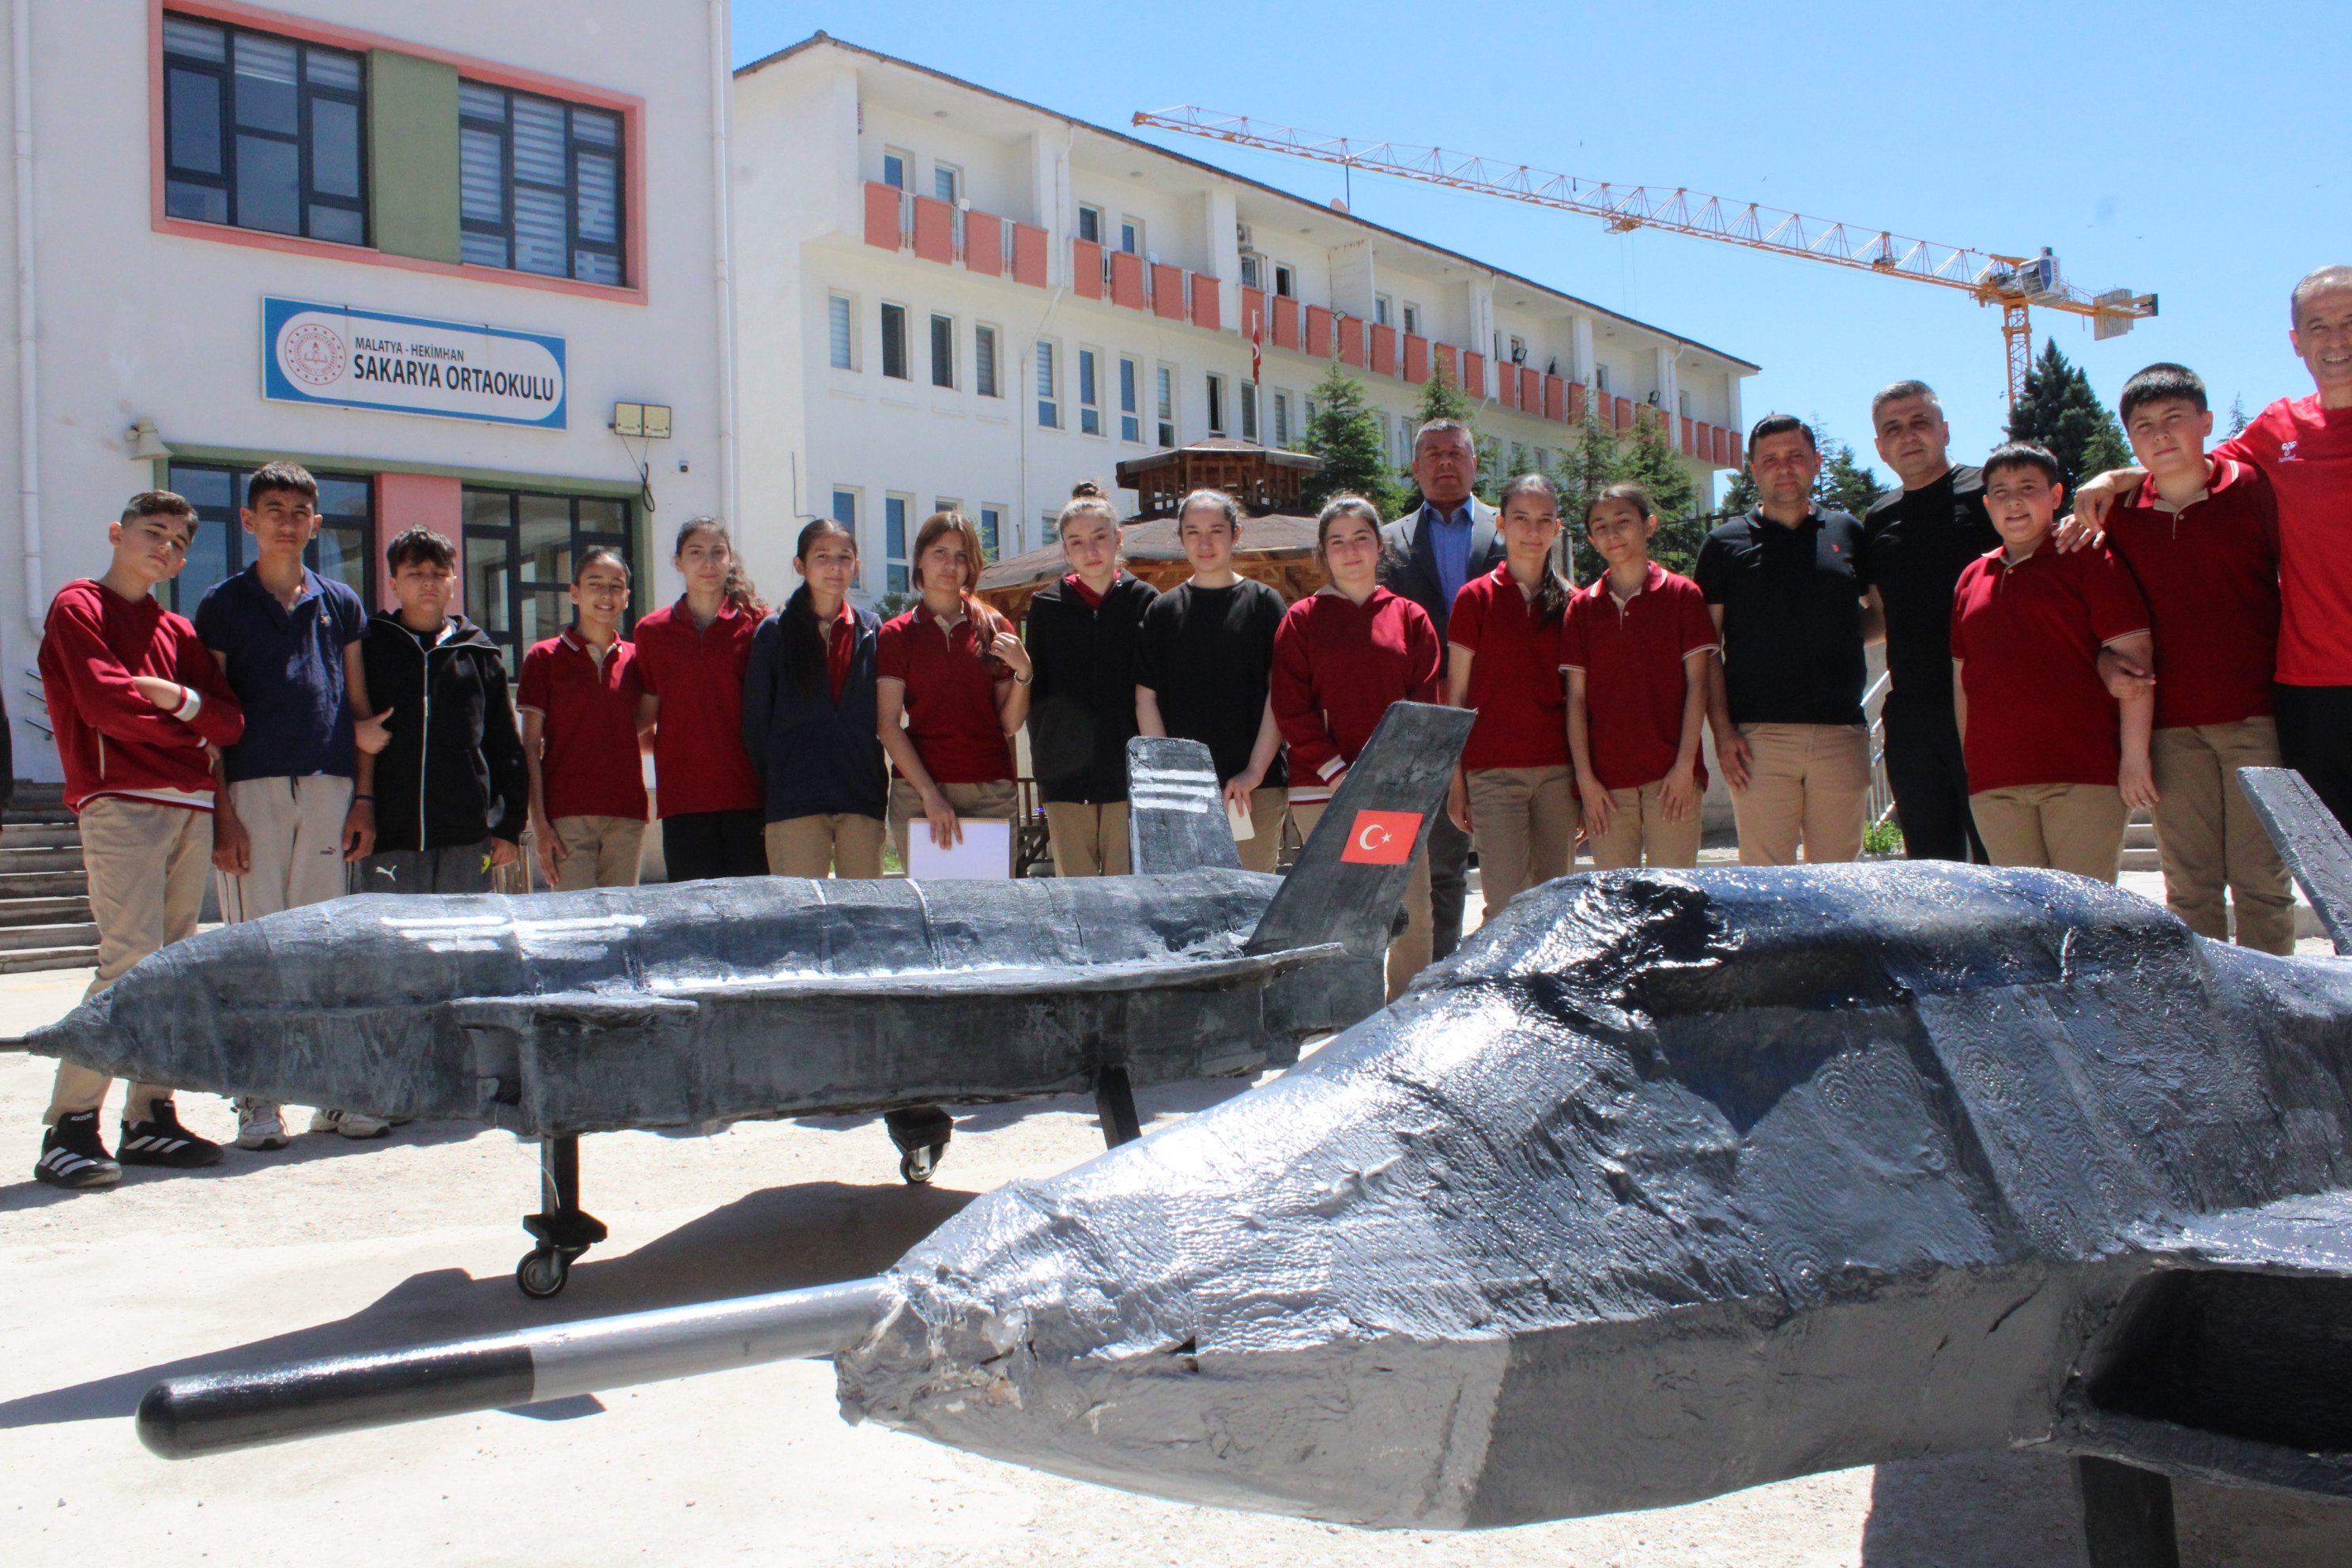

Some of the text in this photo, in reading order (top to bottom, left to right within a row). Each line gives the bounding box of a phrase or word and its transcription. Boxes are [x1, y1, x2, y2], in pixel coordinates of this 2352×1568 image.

[355, 337, 403, 354] MALATYA
[411, 343, 465, 362] HEKİMHAN
[354, 354, 442, 388] SAKARYA
[446, 365, 554, 401] ORTAOKULU
